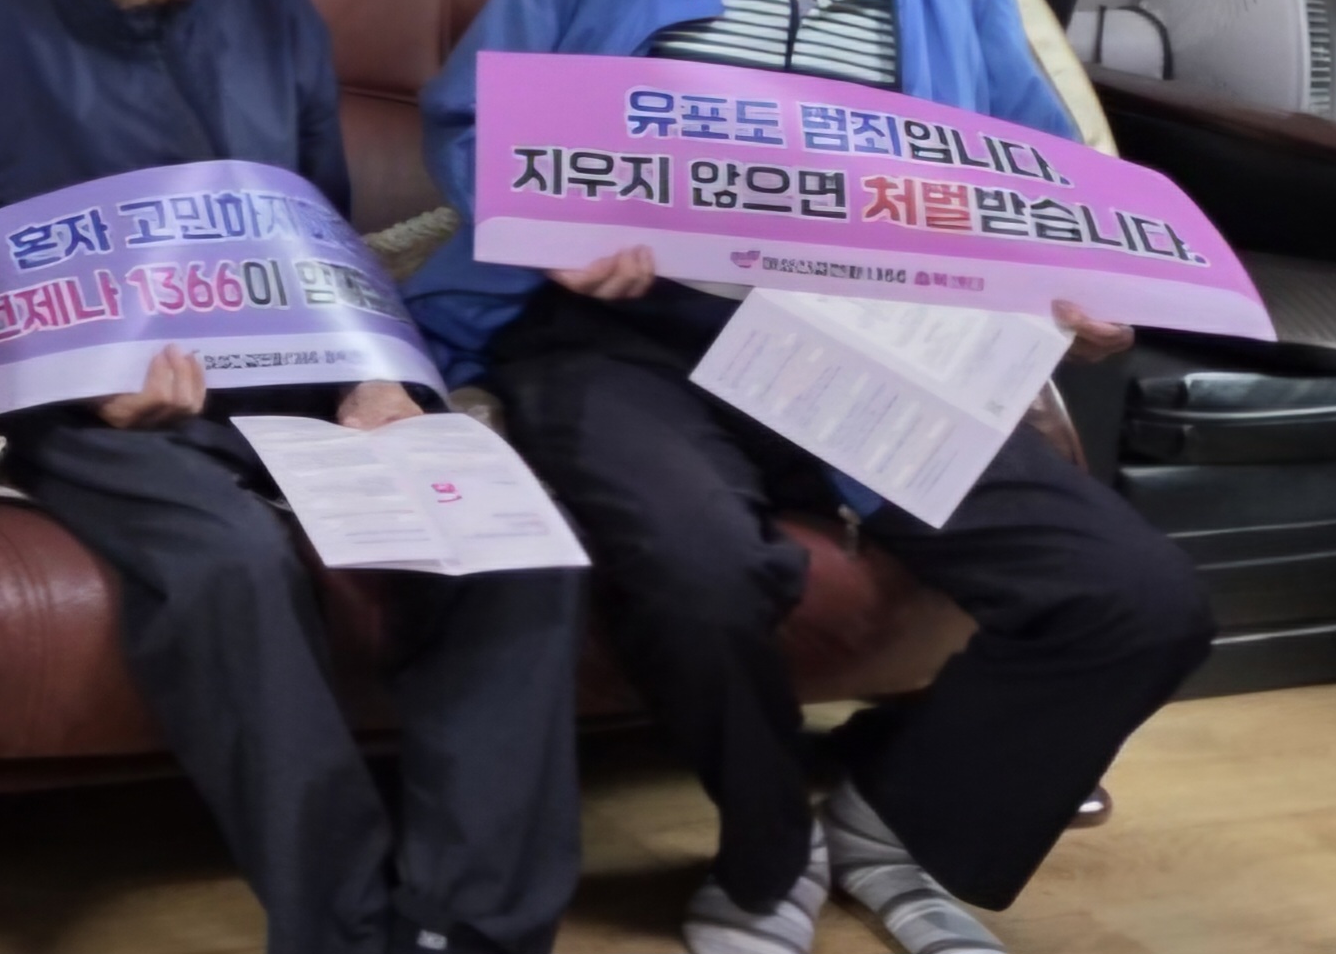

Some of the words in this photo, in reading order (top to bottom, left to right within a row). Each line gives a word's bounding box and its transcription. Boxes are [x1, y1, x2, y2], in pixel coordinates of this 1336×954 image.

[628, 91, 783, 145] 유포도
[801, 104, 1072, 186] 범죄입니다.
[9, 207, 110, 270] 혼자
[512, 148, 669, 204] 지우지
[691, 161, 847, 219] 않으면
[862, 177, 1207, 264] 처벌받습니다.
[126, 260, 289, 314] 1366이
